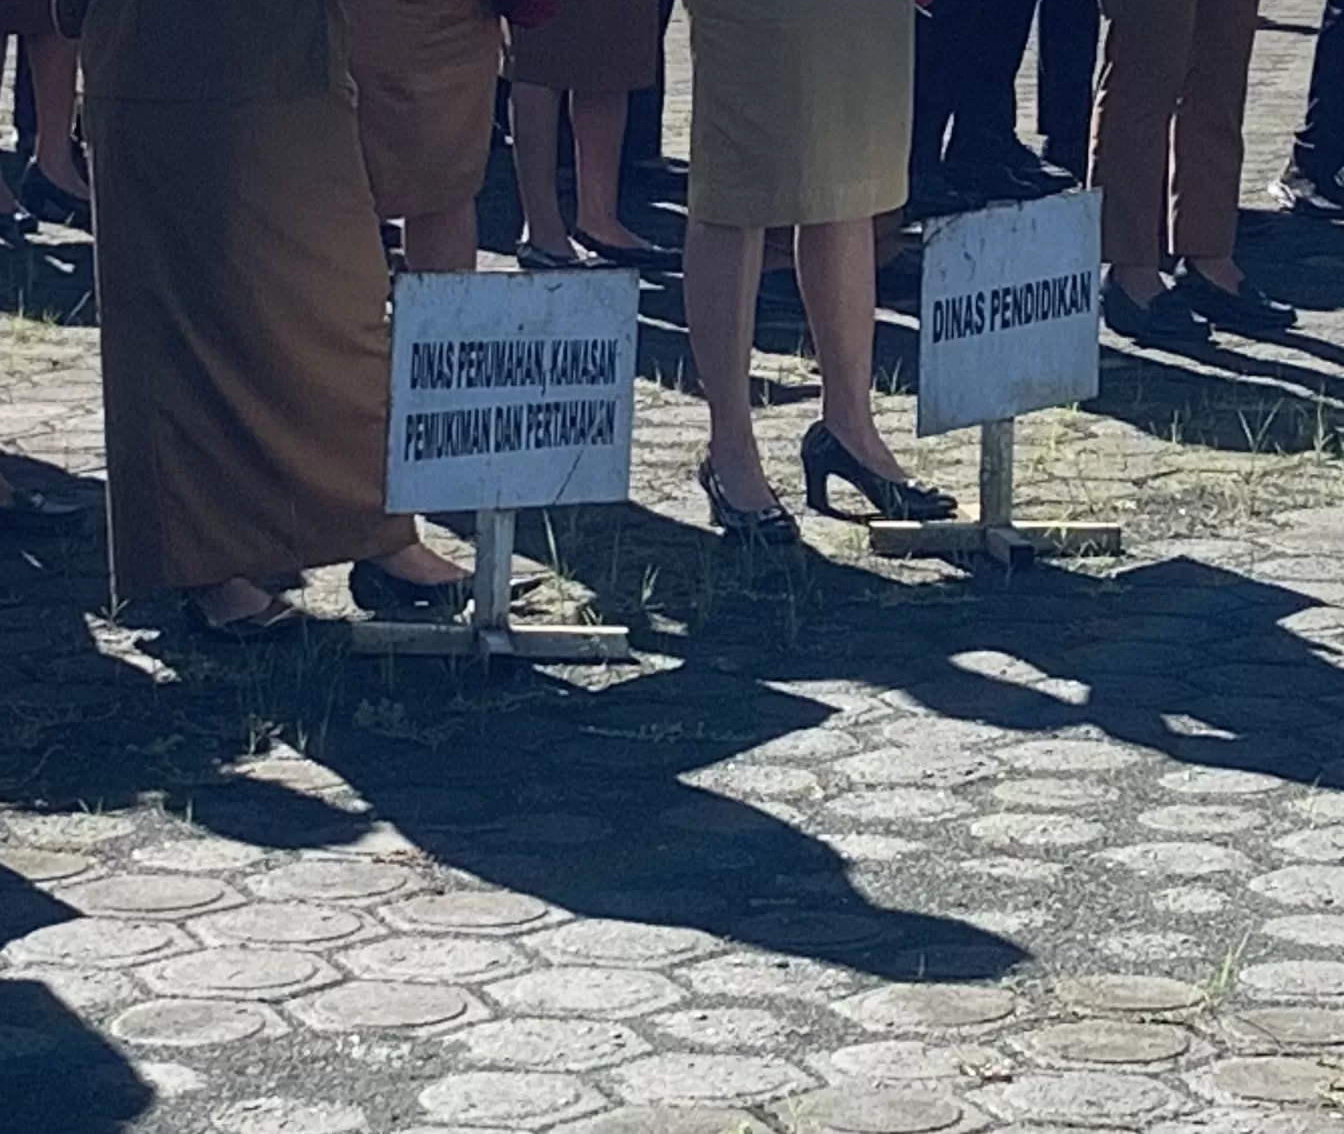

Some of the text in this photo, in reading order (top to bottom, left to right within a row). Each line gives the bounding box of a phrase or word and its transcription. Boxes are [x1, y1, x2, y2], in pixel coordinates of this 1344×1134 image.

[932, 271, 1092, 344] DINAS PENDIDIKAN
[410, 341, 455, 391] DINAS
[549, 338, 618, 386] KAWASAN
[404, 408, 491, 462] PEMUKIMAN
[494, 405, 523, 453] DAN
